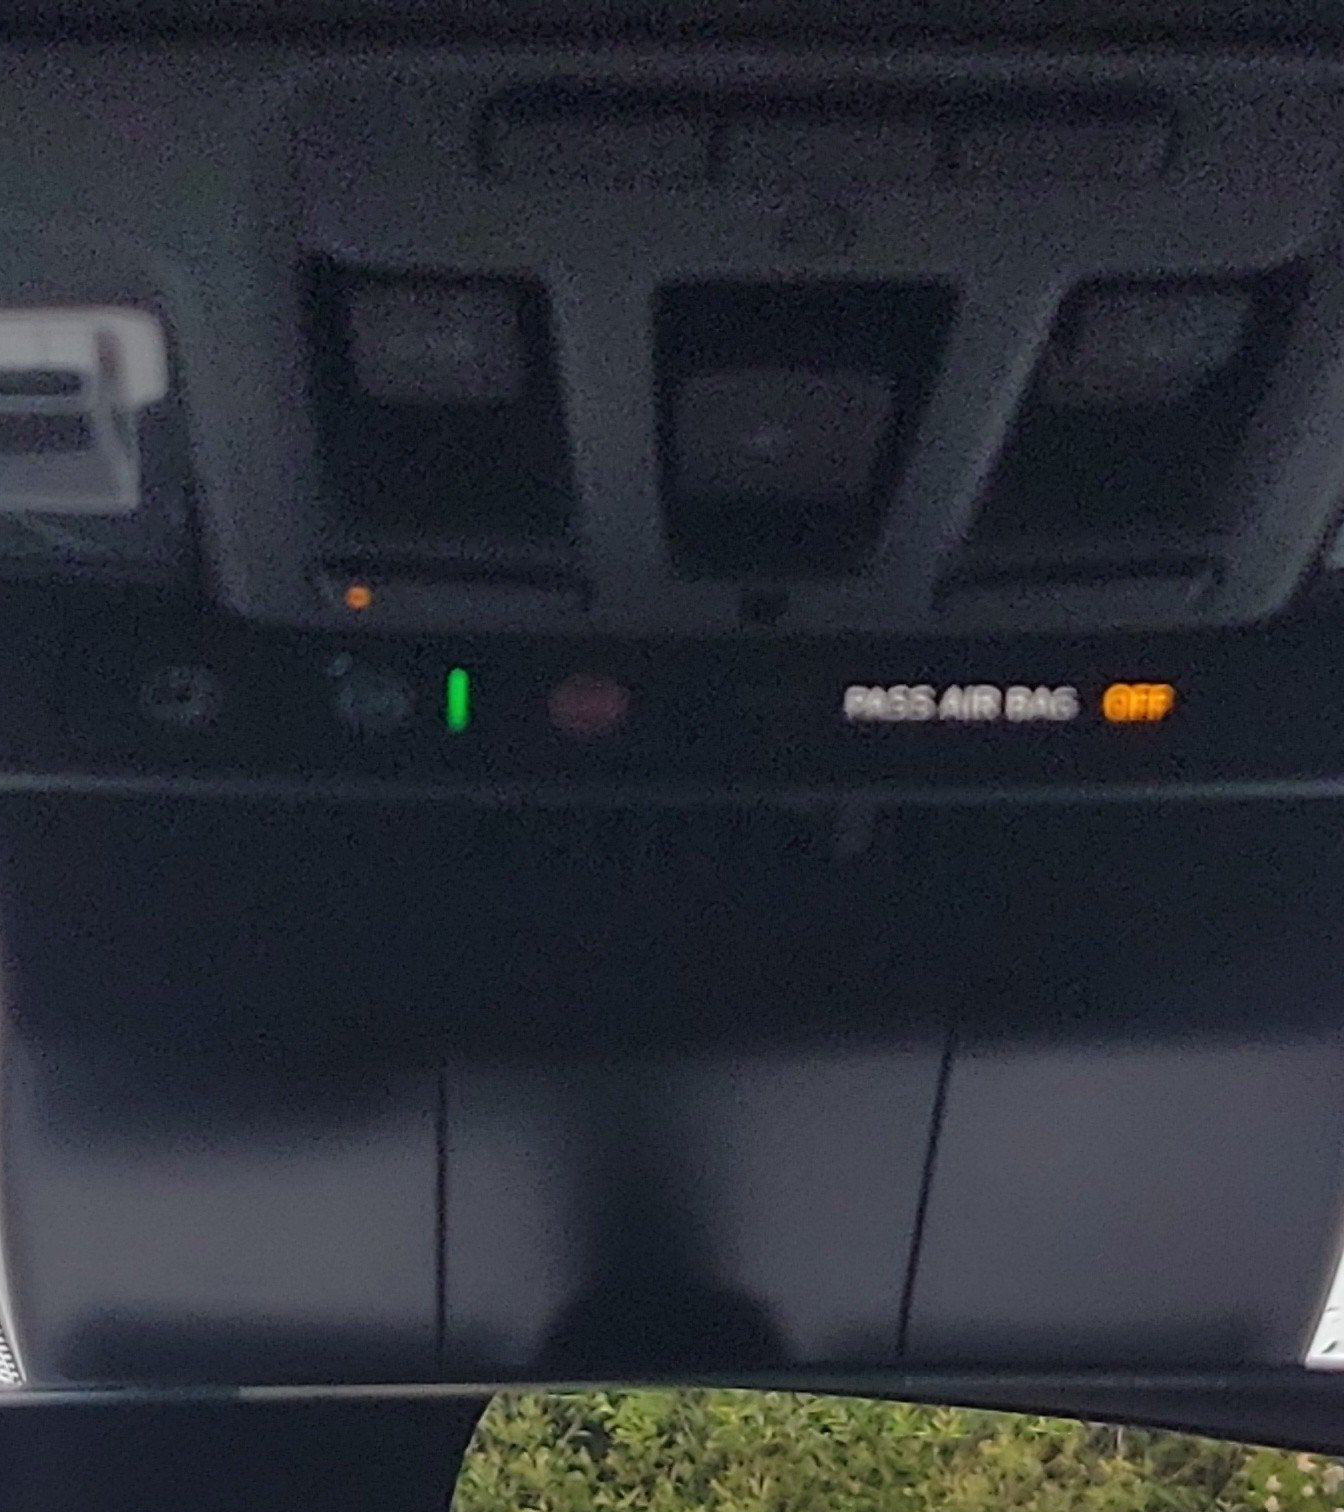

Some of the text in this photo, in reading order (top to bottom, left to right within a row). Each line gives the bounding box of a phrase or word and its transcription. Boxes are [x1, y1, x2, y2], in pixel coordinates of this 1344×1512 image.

[843, 683, 1175, 722] PASS AIR BAG OFF
